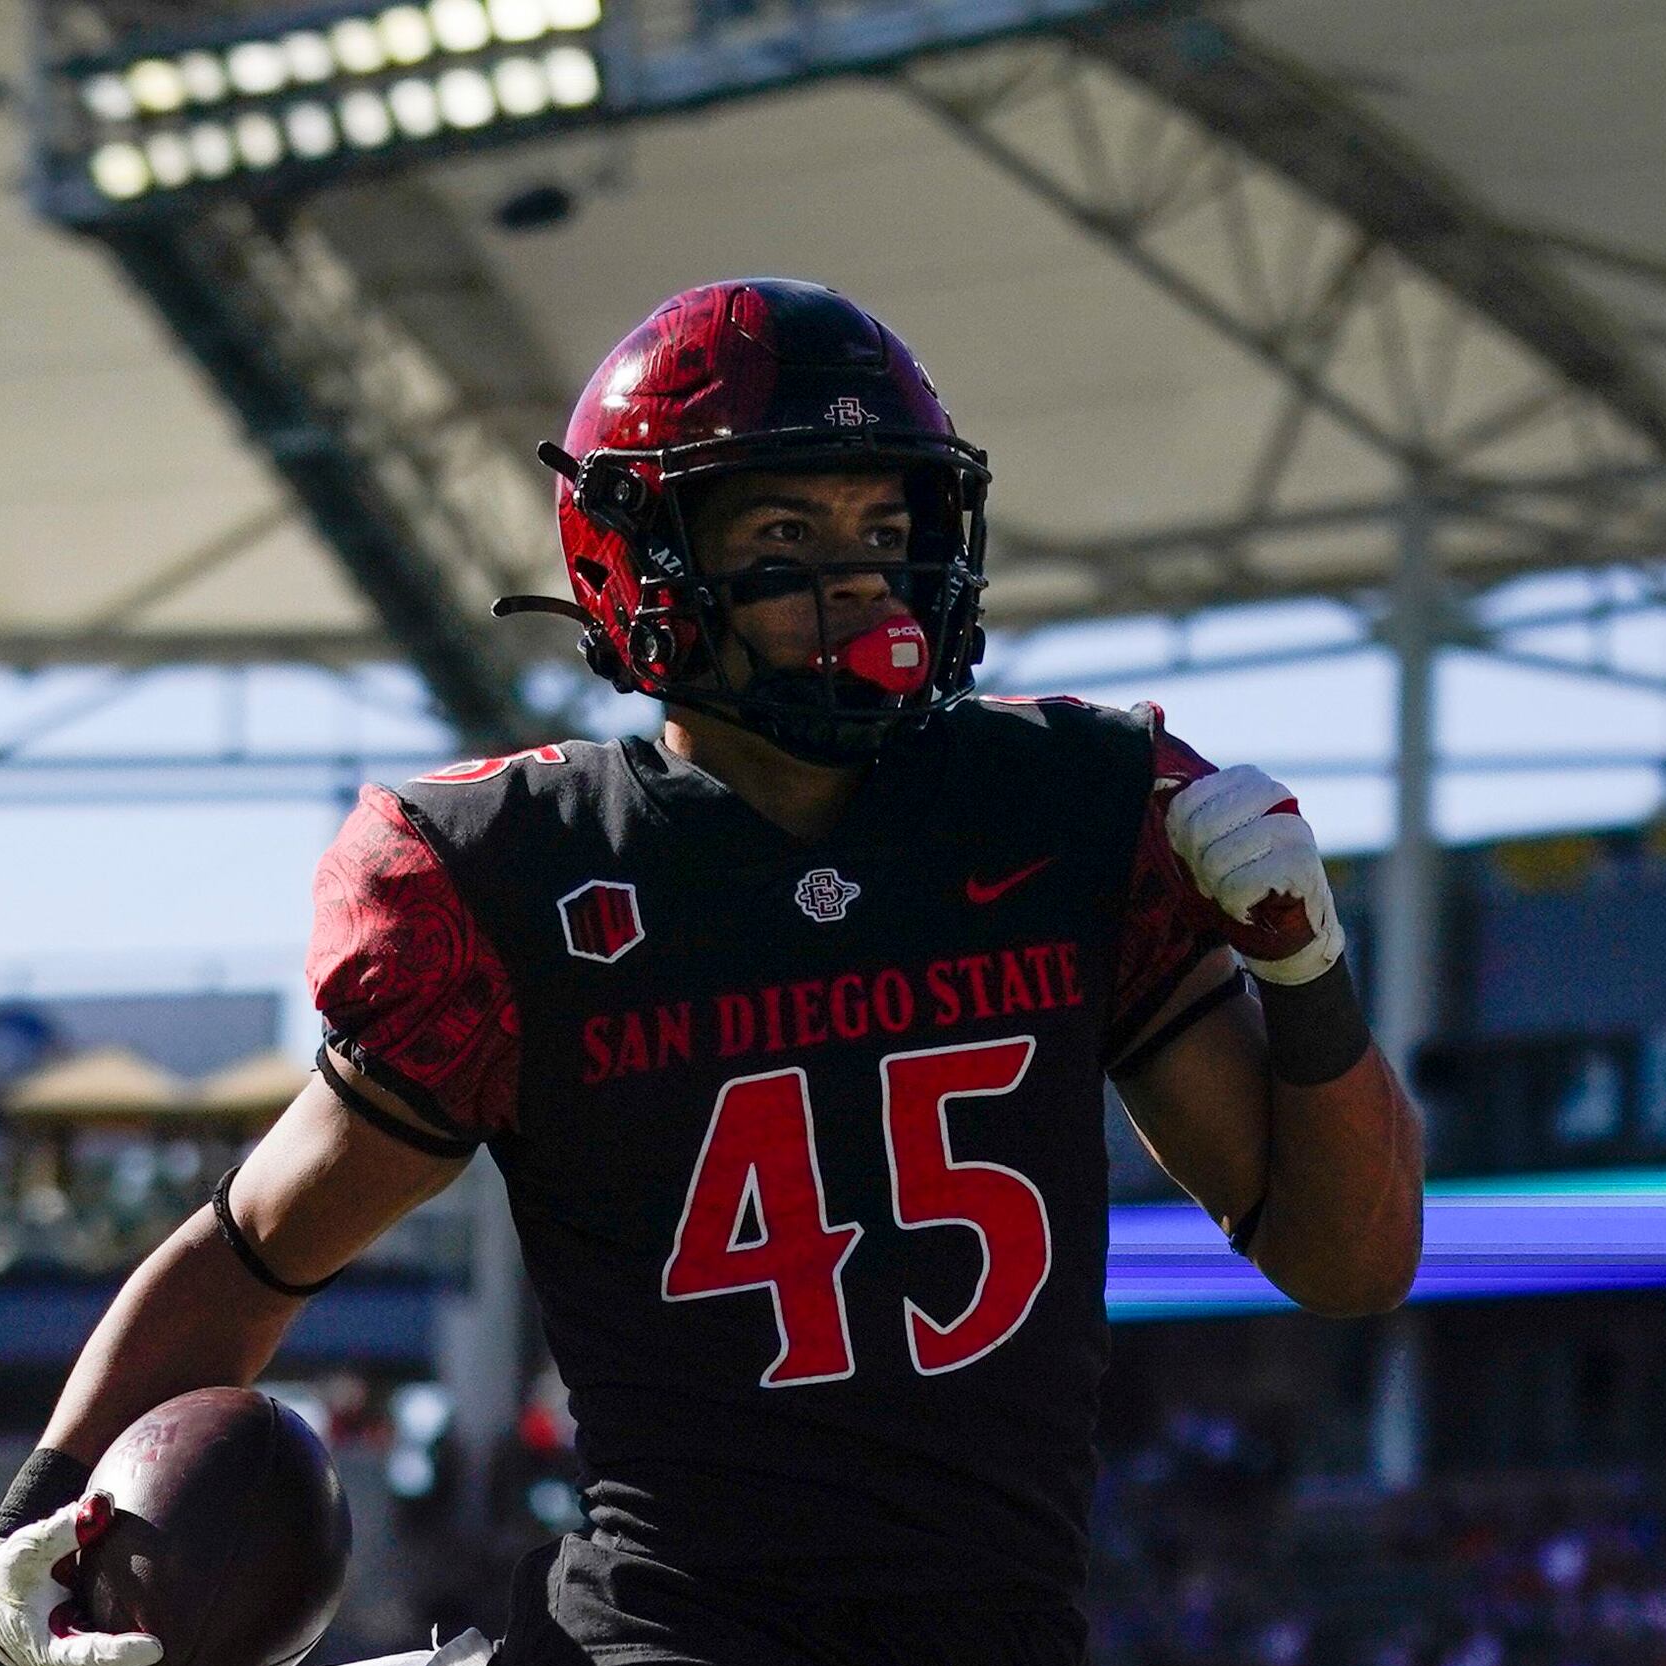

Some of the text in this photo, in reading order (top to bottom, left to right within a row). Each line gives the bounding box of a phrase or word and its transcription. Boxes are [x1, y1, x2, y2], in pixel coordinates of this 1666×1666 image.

[581, 941, 1085, 1084] SAN DIEGO STATE
[661, 1034, 1052, 1389] 45
